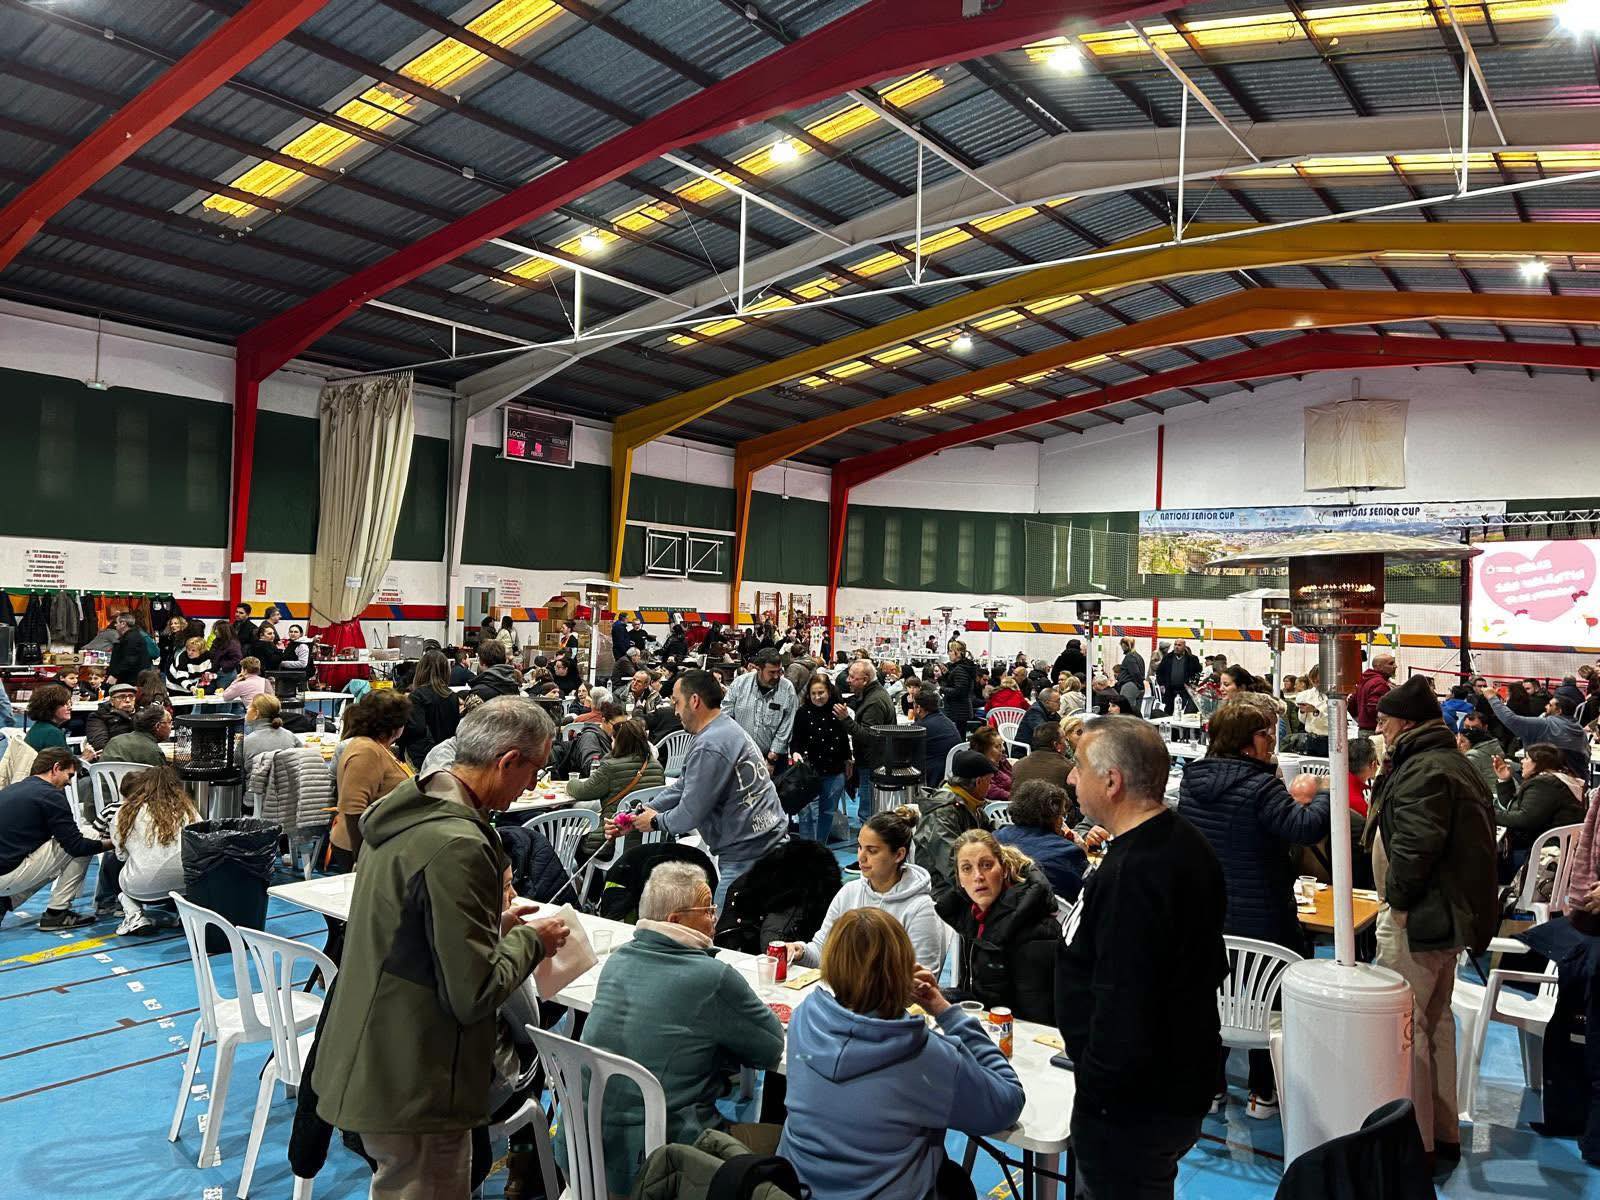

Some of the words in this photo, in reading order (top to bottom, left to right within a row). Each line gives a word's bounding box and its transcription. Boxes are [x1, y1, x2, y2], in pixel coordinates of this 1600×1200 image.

[509, 429, 527, 439] LOCAL
[1160, 512, 1190, 521] NATIONS
[1191, 511, 1218, 520] SENIOR
[1219, 511, 1235, 520] CUP
[1333, 507, 1368, 518] NATIONS
[1369, 506, 1400, 516] SENIOR
[1401, 506, 1421, 516] CUP
